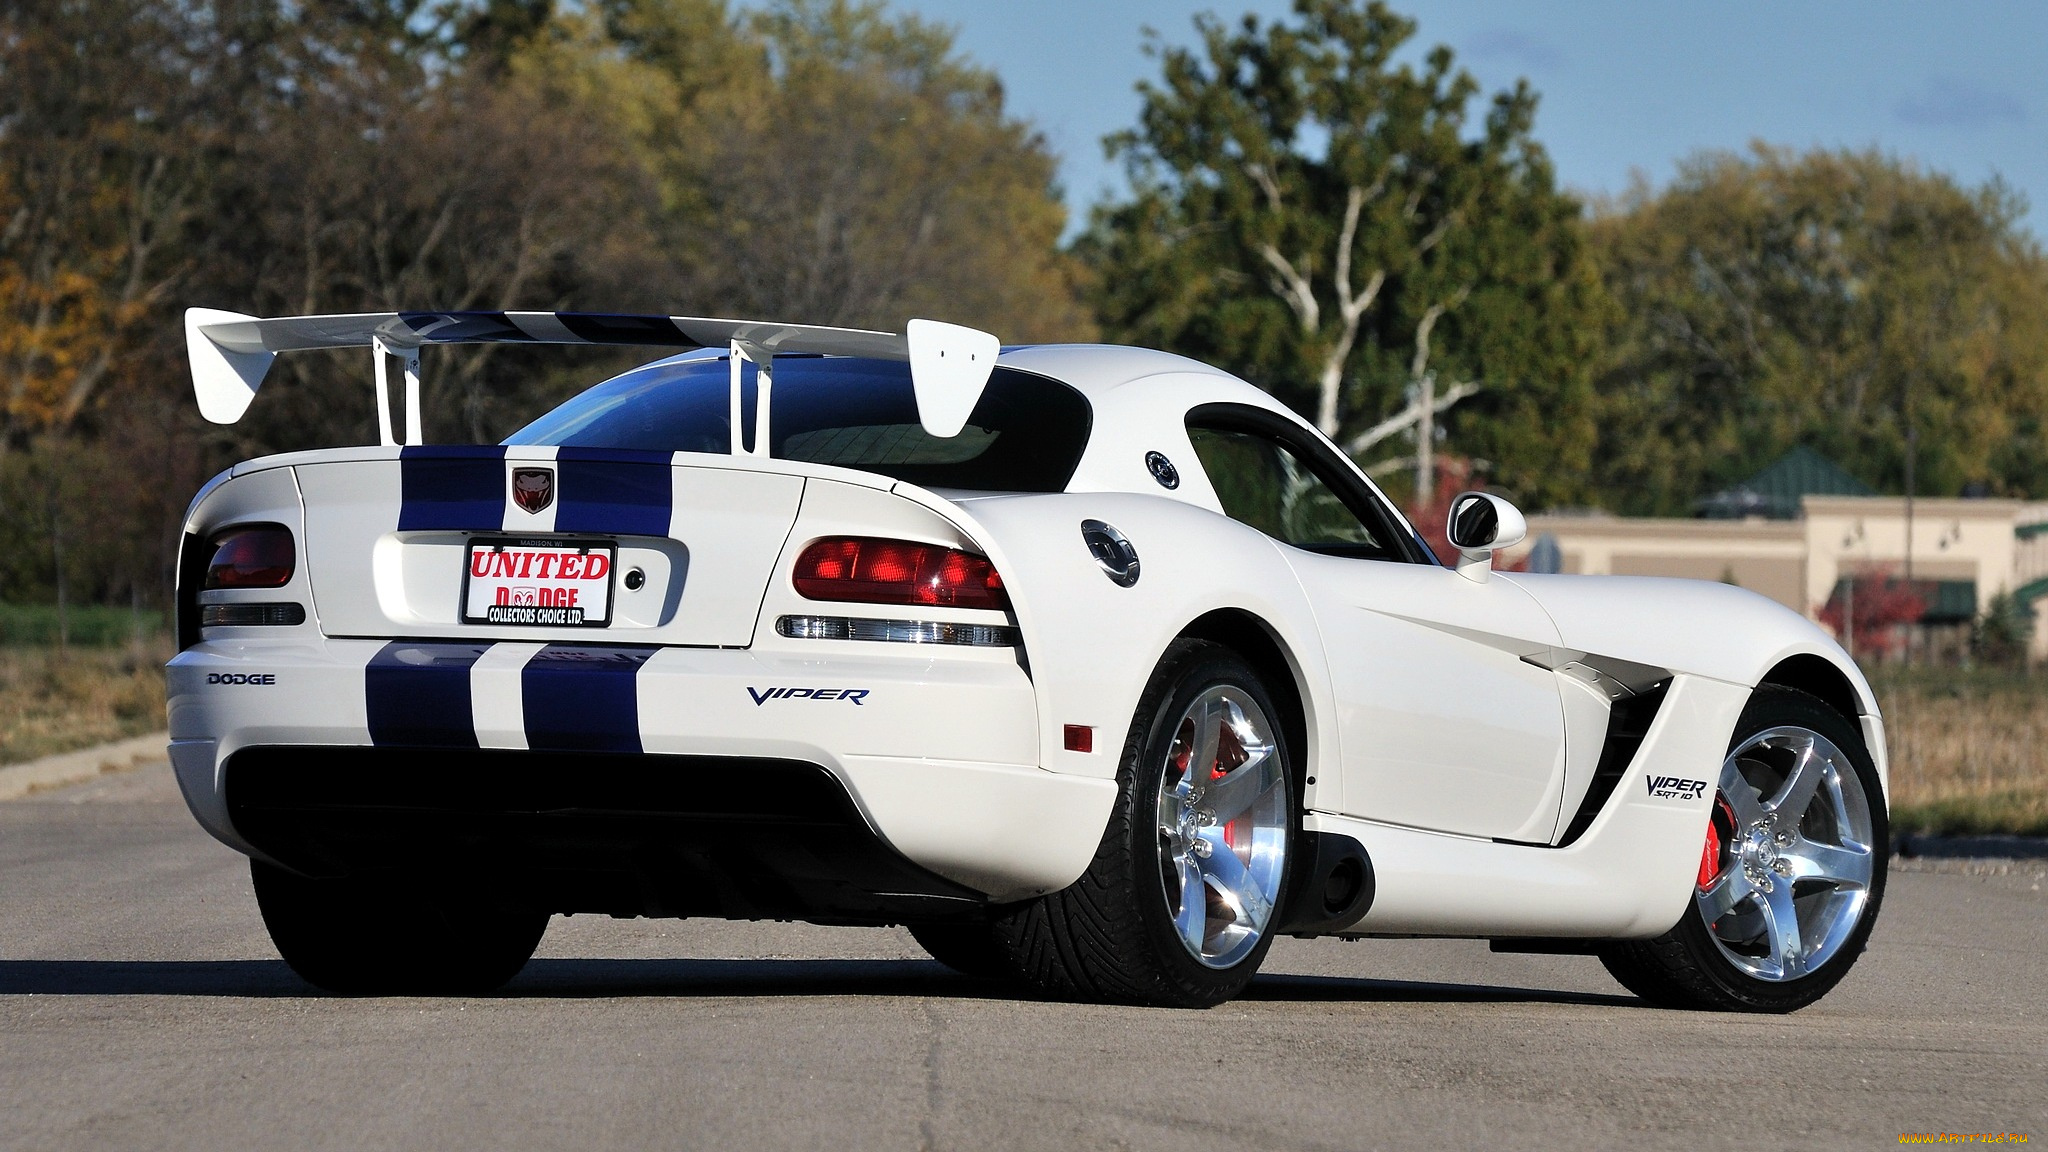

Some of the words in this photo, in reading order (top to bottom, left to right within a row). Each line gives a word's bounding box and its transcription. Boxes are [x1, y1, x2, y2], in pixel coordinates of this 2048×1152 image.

[471, 551, 610, 580] UNITED
[489, 607, 535, 623] COLLECTORS
[537, 608, 566, 624] CHOICE
[567, 610, 583, 625] LTD.
[207, 673, 276, 685] DODGE
[746, 687, 870, 706] VIPER
[1646, 775, 1708, 799] VIPER
[1653, 790, 1679, 800] SRT
